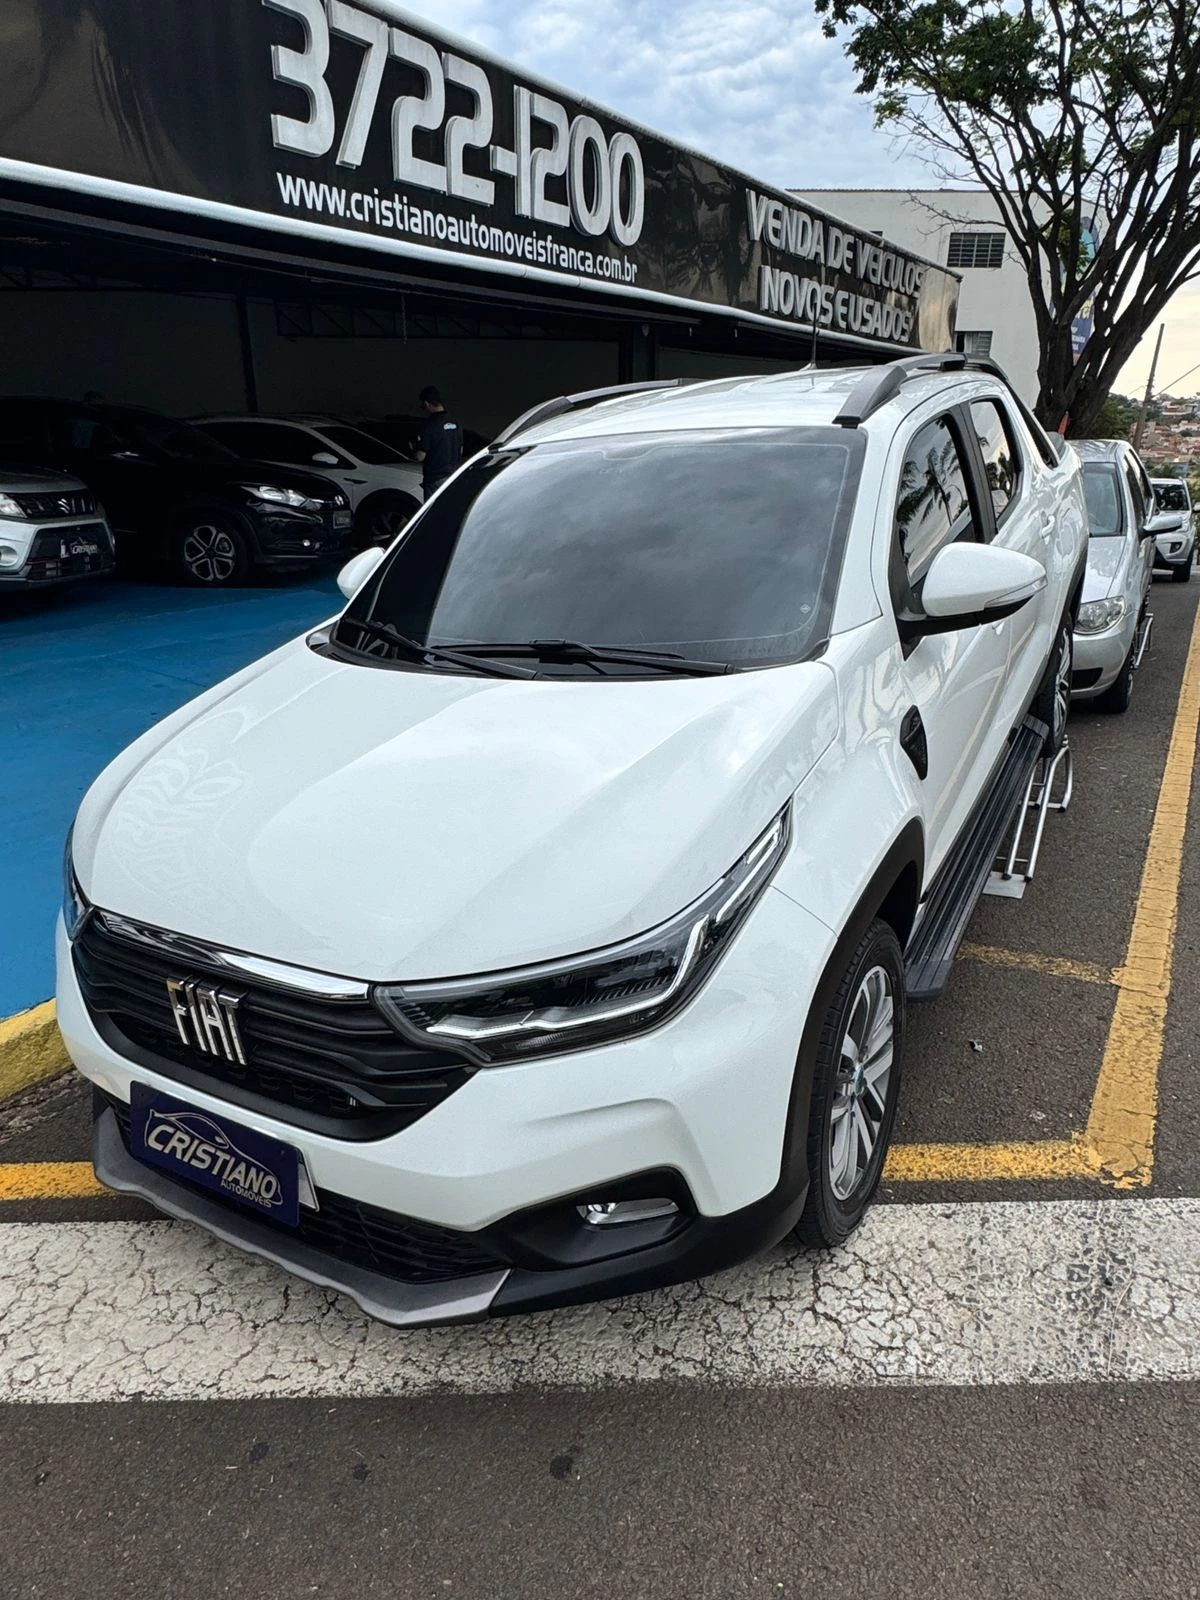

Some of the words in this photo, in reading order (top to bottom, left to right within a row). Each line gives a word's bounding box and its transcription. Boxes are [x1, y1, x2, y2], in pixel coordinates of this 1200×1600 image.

[262, 0, 645, 247] 3722-1200
[276, 172, 638, 284] www.cristianoautomoveisfranca.com.br
[745, 188, 824, 264] VENDA
[827, 226, 855, 275] DE
[758, 265, 834, 324] NOVOS
[834, 293, 849, 329] E
[849, 293, 911, 343] USADOS
[167, 976, 247, 1066] FIAT
[147, 1123, 278, 1200] CRISTIANO
